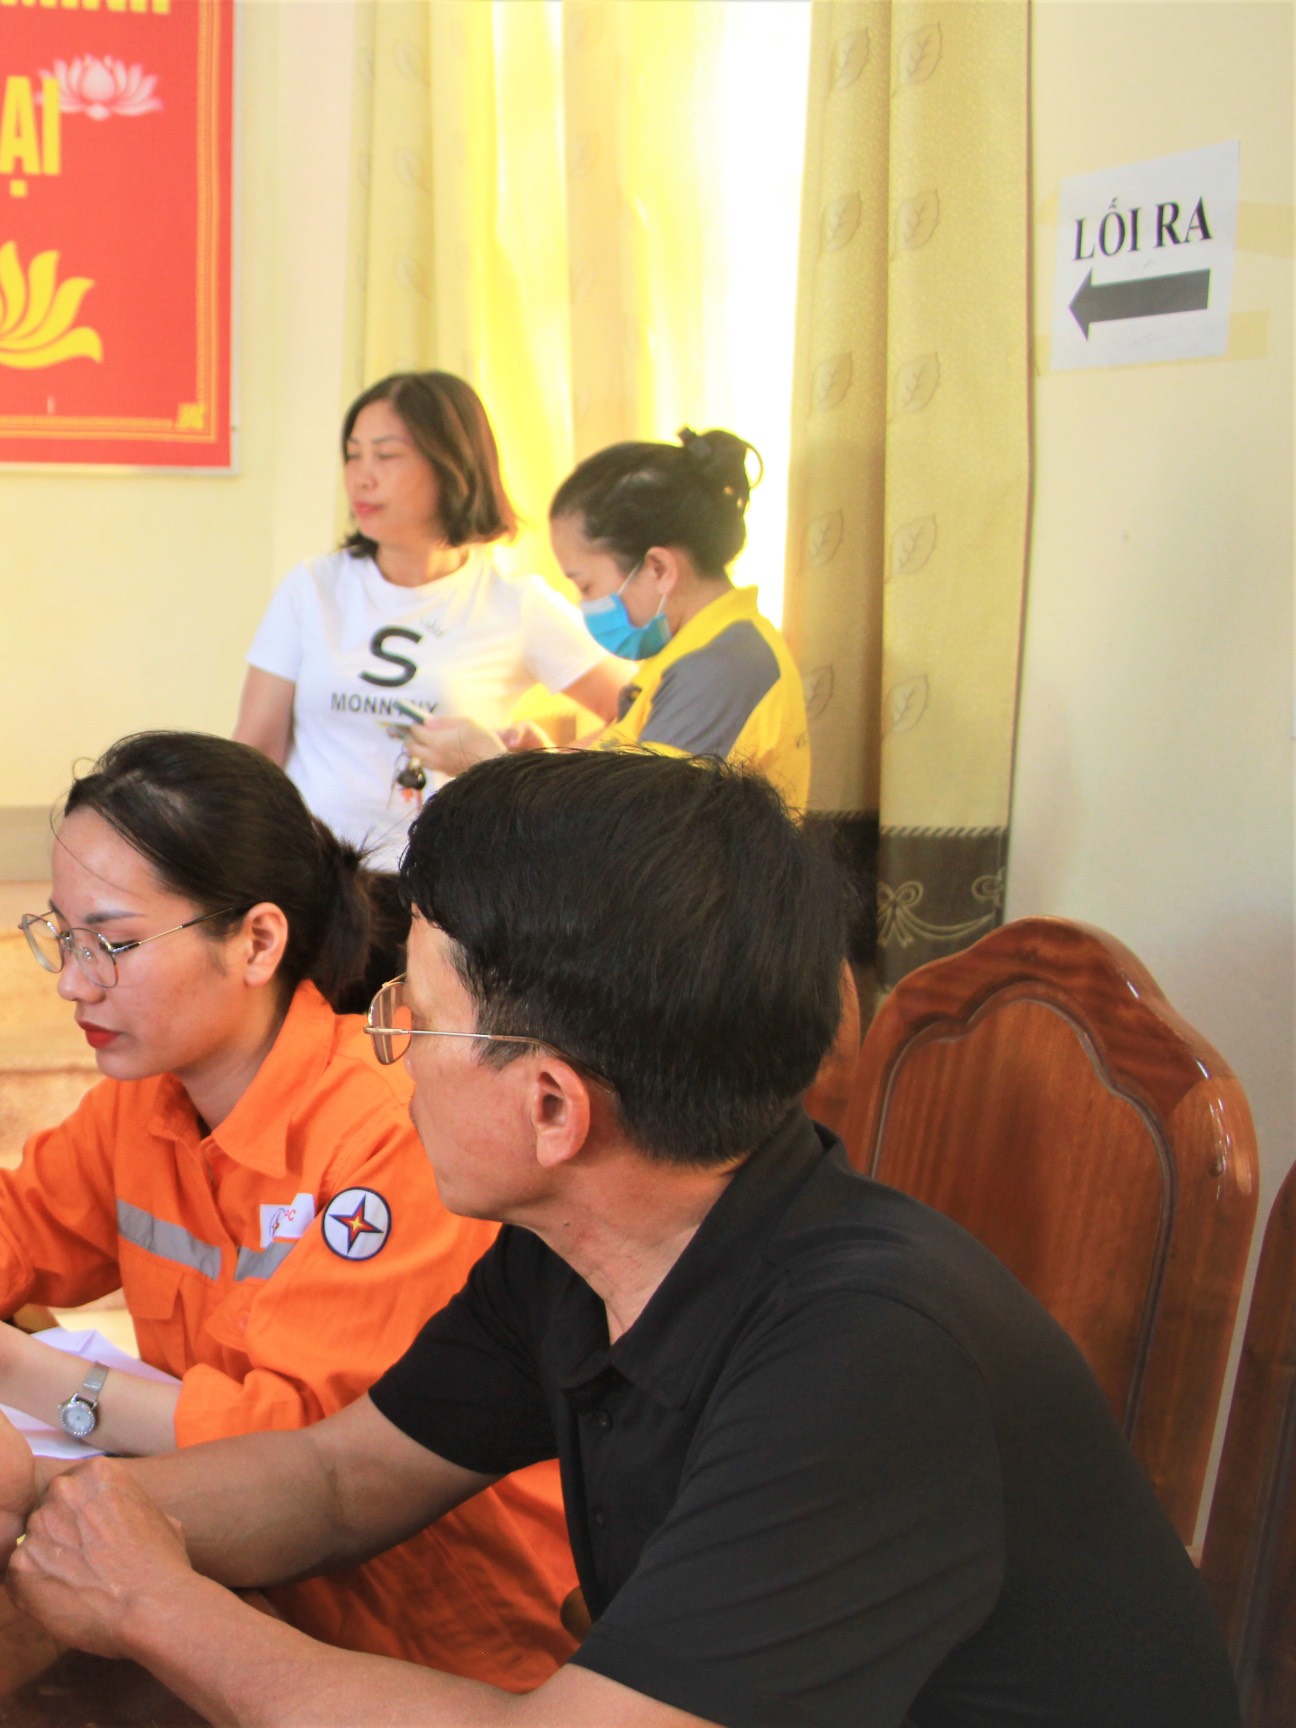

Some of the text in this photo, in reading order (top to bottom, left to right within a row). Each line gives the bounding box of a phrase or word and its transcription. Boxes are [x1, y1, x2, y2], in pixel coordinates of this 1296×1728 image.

[1072, 195, 1214, 261] LỐI RA
[358, 624, 423, 688] S
[330, 692, 439, 717] MONNY
